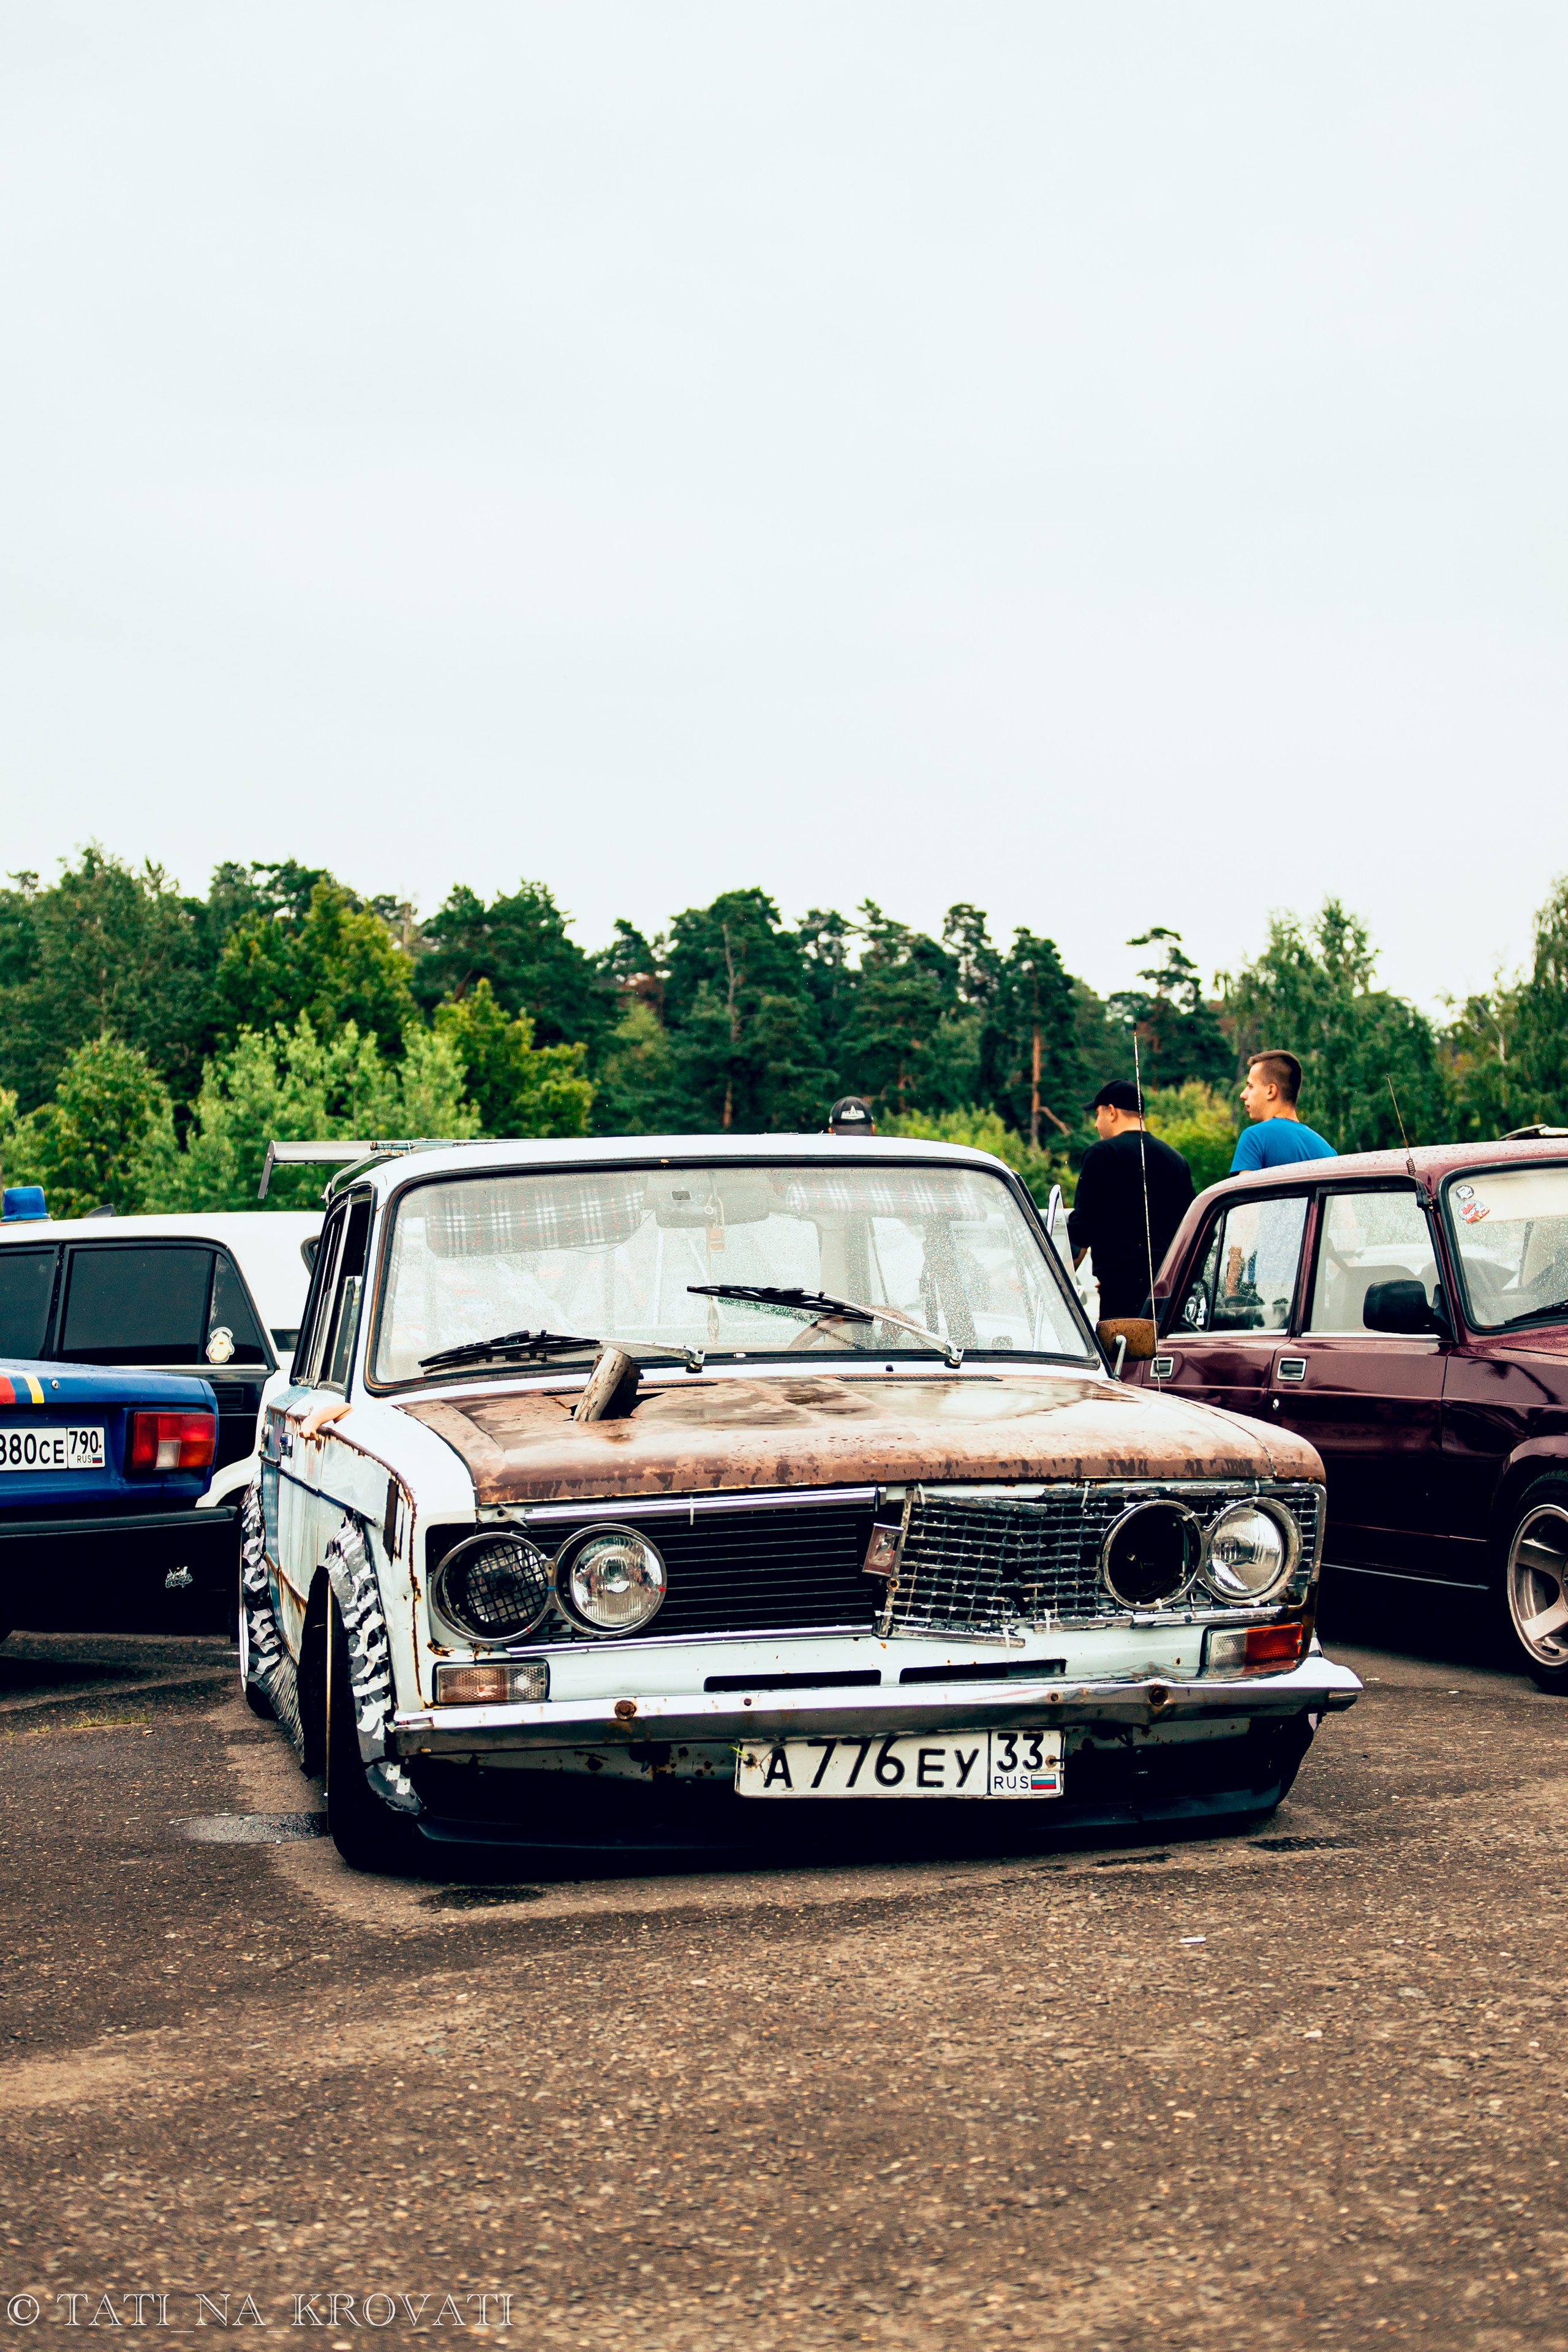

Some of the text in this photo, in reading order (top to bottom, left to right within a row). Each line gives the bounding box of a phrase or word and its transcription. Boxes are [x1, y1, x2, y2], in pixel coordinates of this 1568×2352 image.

[69, 1430, 98, 1454] 790
[77, 1455, 91, 1463] RUS
[996, 1733, 1044, 1773] 33
[994, 1776, 1029, 1795] RUS
